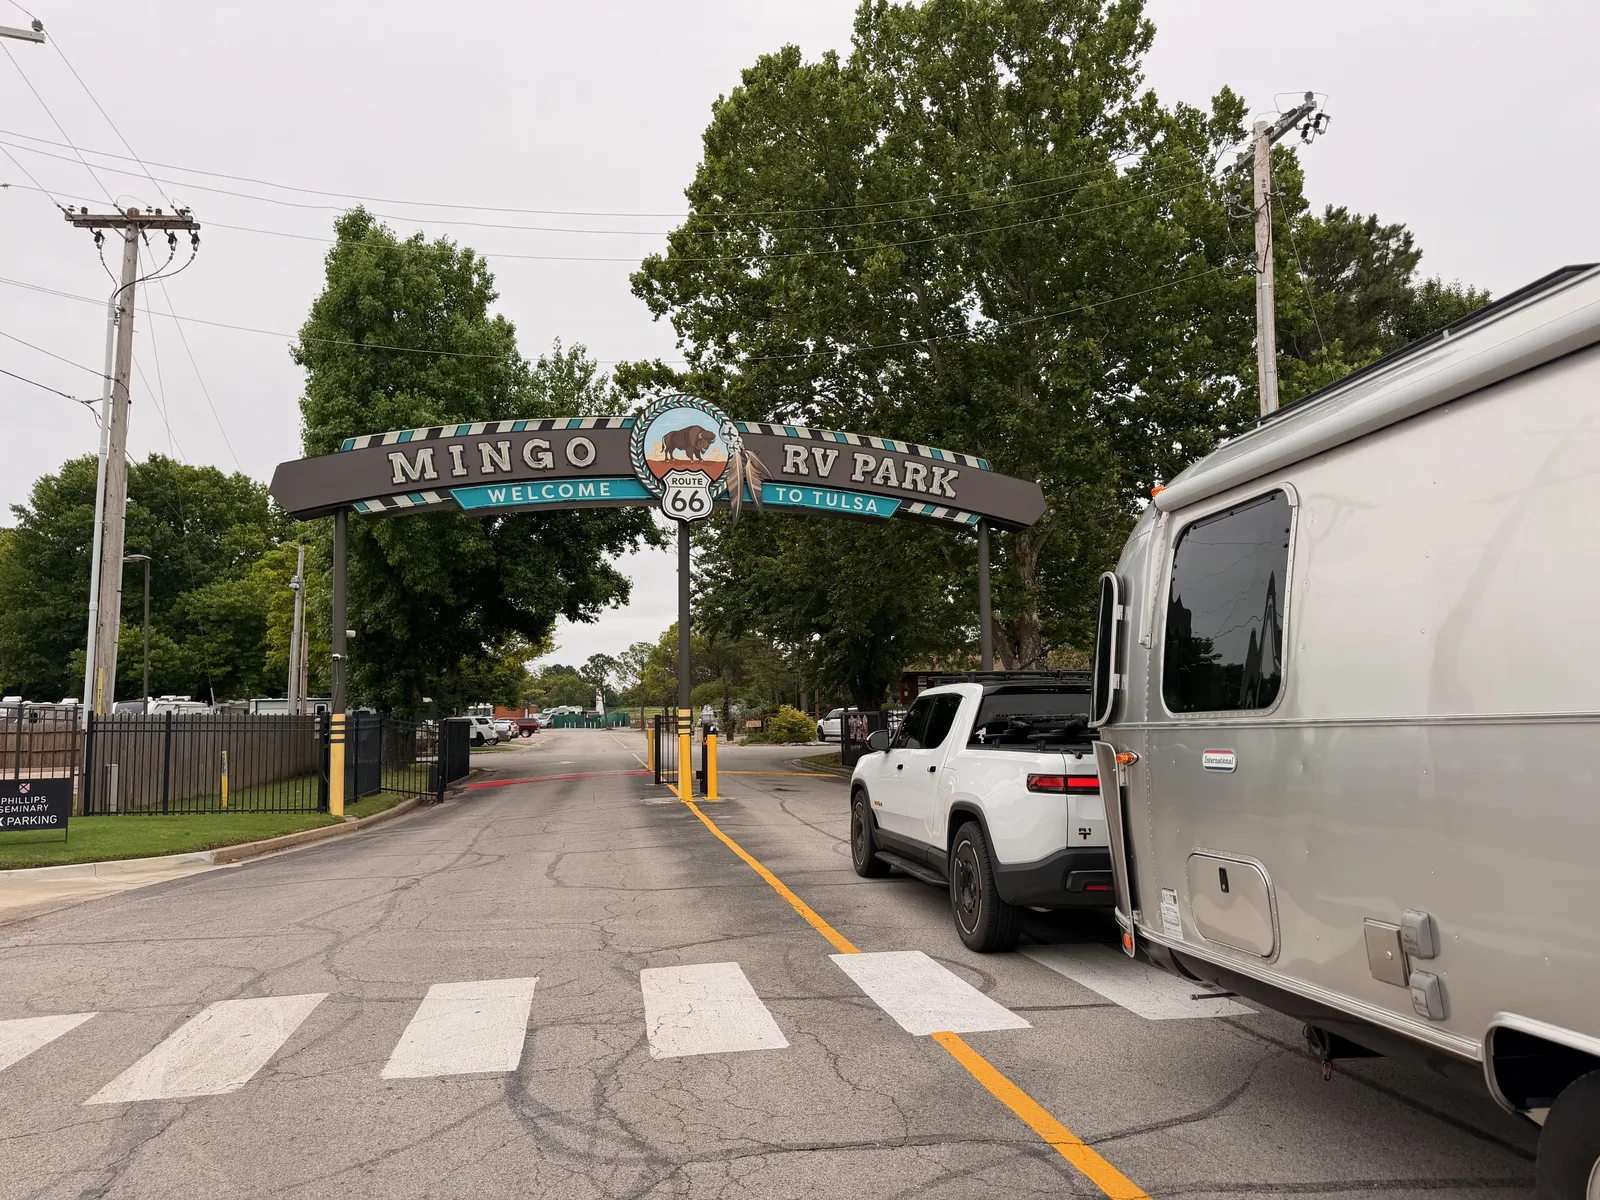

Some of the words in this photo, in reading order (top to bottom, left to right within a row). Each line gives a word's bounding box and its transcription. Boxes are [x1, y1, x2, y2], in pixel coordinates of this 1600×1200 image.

[387, 436, 598, 484] MINGO
[782, 443, 839, 477] RV
[851, 451, 960, 498] PARK
[671, 477, 703, 486] ROUTE
[487, 481, 612, 503] WELCOME
[775, 487, 803, 503] TO
[812, 490, 878, 513] TULSA
[671, 489, 705, 512] 66
[1203, 755, 1234, 765] International
[1, 796, 47, 805] PHILLIPS
[0, 804, 49, 814] SEMINARY
[7, 814, 58, 826] PARKING
